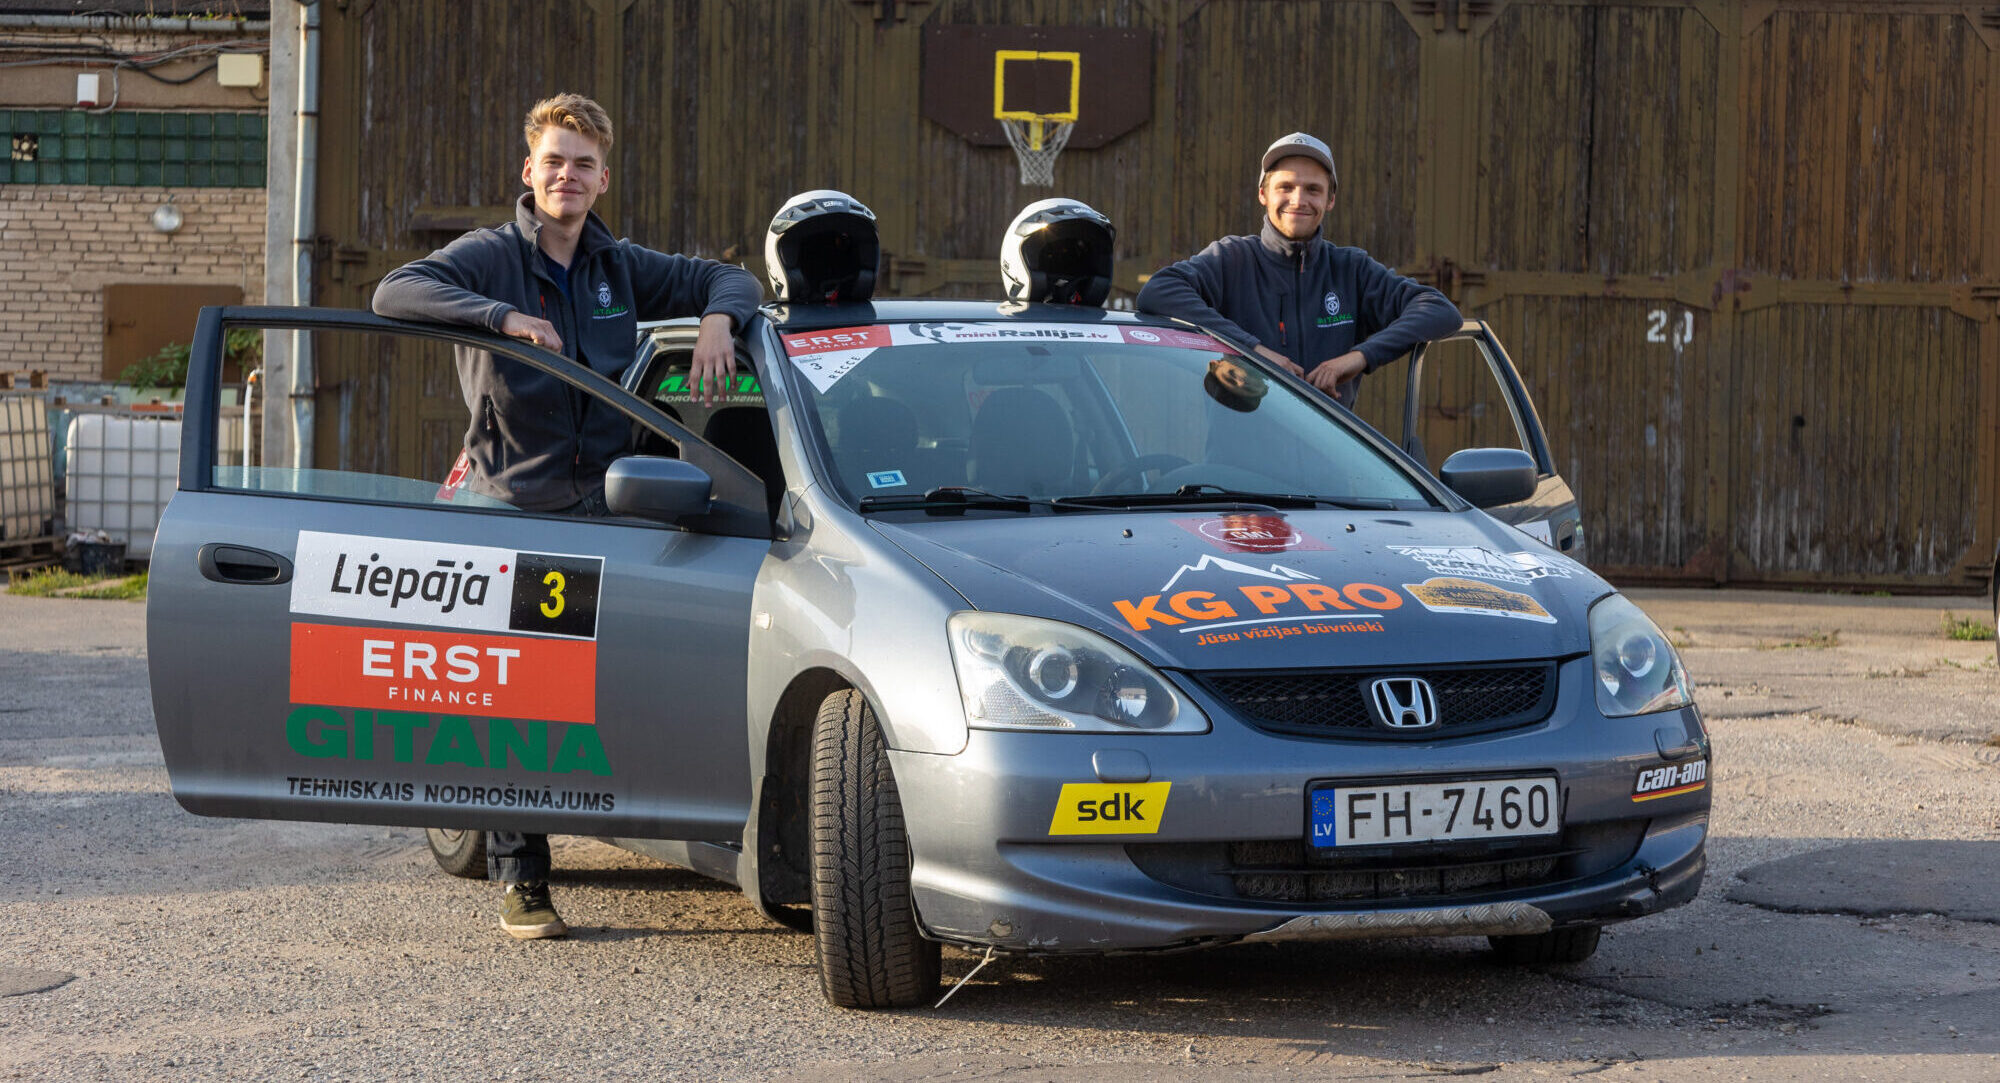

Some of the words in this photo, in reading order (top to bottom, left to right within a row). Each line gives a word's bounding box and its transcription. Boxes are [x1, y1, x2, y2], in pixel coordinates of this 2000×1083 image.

[788, 331, 870, 349] ERST
[810, 340, 866, 351] FINANCE
[809, 362, 823, 371] 3
[828, 355, 861, 380] RECCE
[539, 570, 567, 619] 3
[1112, 590, 1238, 632] KG
[1238, 582, 1403, 614] PRO
[1196, 631, 1240, 646] Jūsu
[1245, 624, 1302, 641] vīzijas
[1303, 620, 1385, 636] būvnieki
[362, 639, 520, 685] ERST
[388, 686, 493, 706] FINANCE
[285, 705, 614, 777] GITANA
[1635, 758, 1708, 793] can-am
[286, 776, 415, 801] TEHNISKAIS
[424, 782, 615, 812] NODROŠINĀJUMS
[1077, 792, 1146, 822] sdk
[1346, 783, 1551, 840] FH-7460
[1313, 822, 1333, 837] LV
